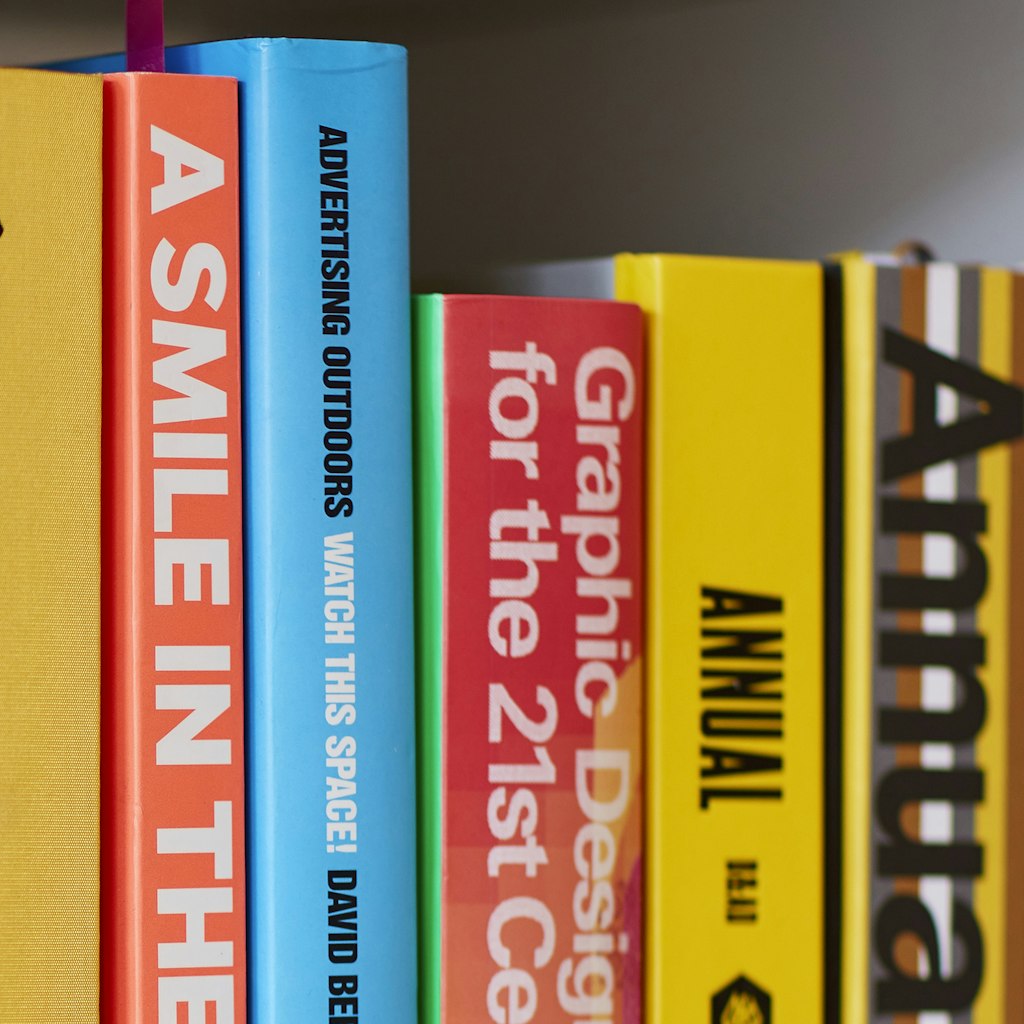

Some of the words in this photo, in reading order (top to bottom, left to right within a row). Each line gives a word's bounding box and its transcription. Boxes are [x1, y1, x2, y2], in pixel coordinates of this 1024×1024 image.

[150, 124, 225, 215] A
[318, 124, 352, 336] ADVERTISING
[150, 237, 231, 606] SMILE
[321, 345, 354, 518] OUTDOORS
[488, 341, 558, 480] for
[324, 531, 355, 644] WATCH
[487, 499, 558, 658] the
[560, 346, 636, 720] Graphic
[154, 645, 232, 766] IN
[324, 653, 356, 725] THIS
[698, 585, 785, 811] ANNUAL
[325, 735, 358, 853] SPACE!
[487, 683, 558, 878] 21st
[327, 869, 359, 965] DAVID
